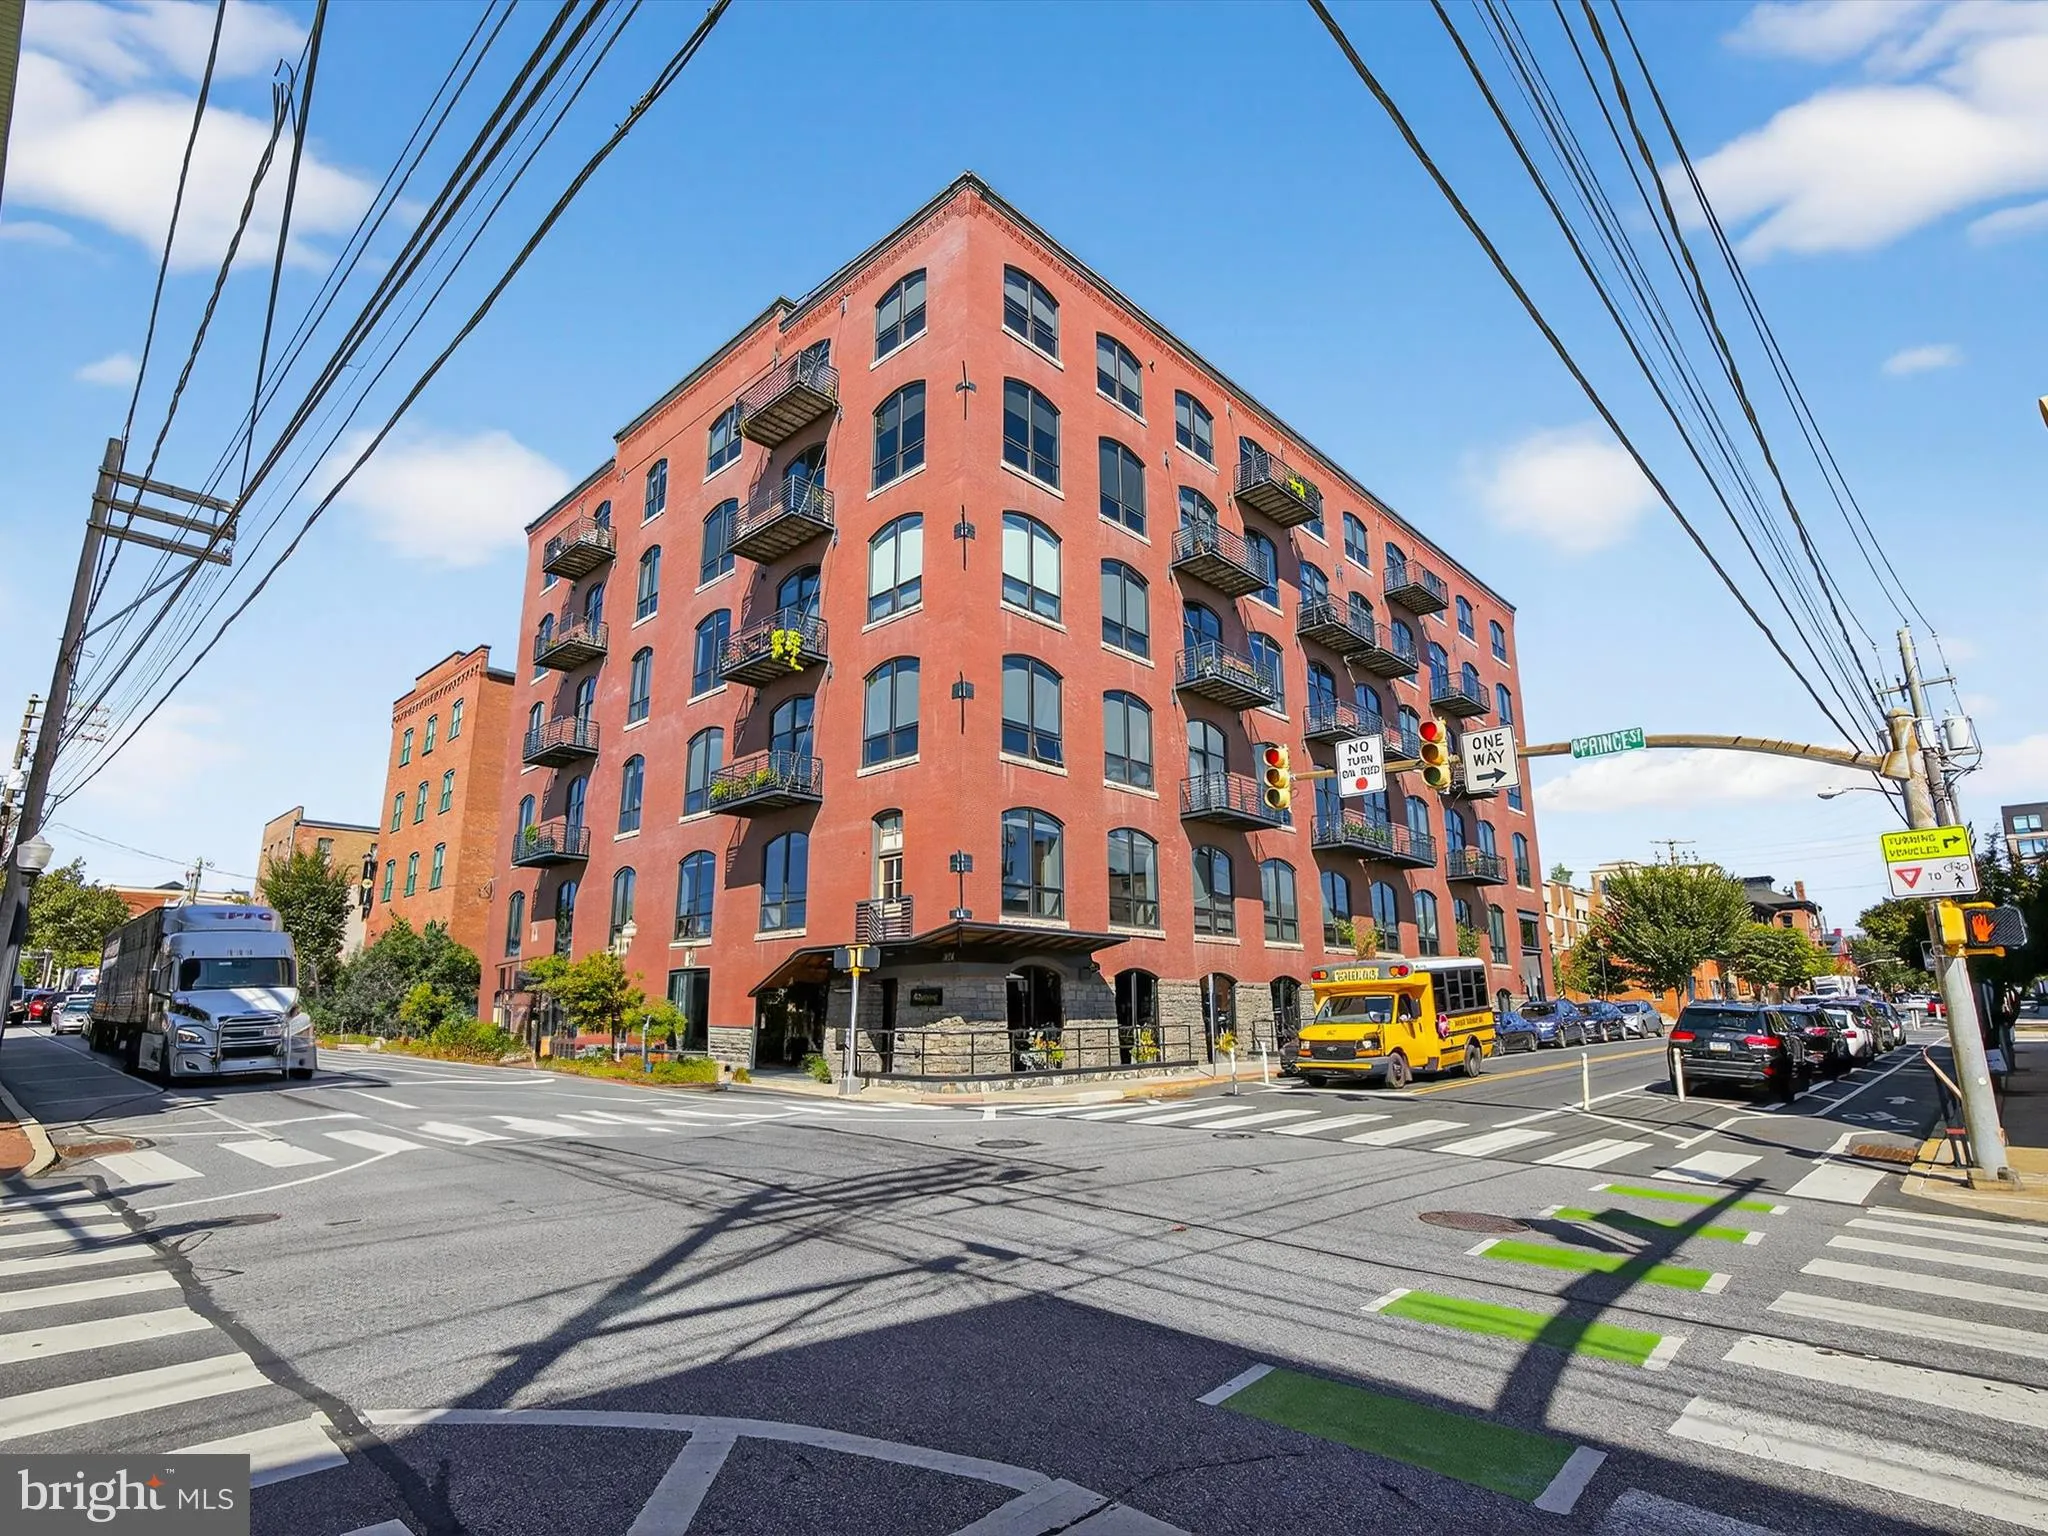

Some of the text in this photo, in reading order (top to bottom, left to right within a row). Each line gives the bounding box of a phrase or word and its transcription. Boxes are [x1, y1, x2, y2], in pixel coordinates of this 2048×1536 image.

[1348, 741, 1369, 755] NO
[1472, 733, 1504, 750] ONE
[1580, 731, 1631, 756] PRINCE
[1347, 755, 1373, 767] TURN
[1473, 749, 1505, 767] WAY
[1928, 872, 1942, 880] TO
